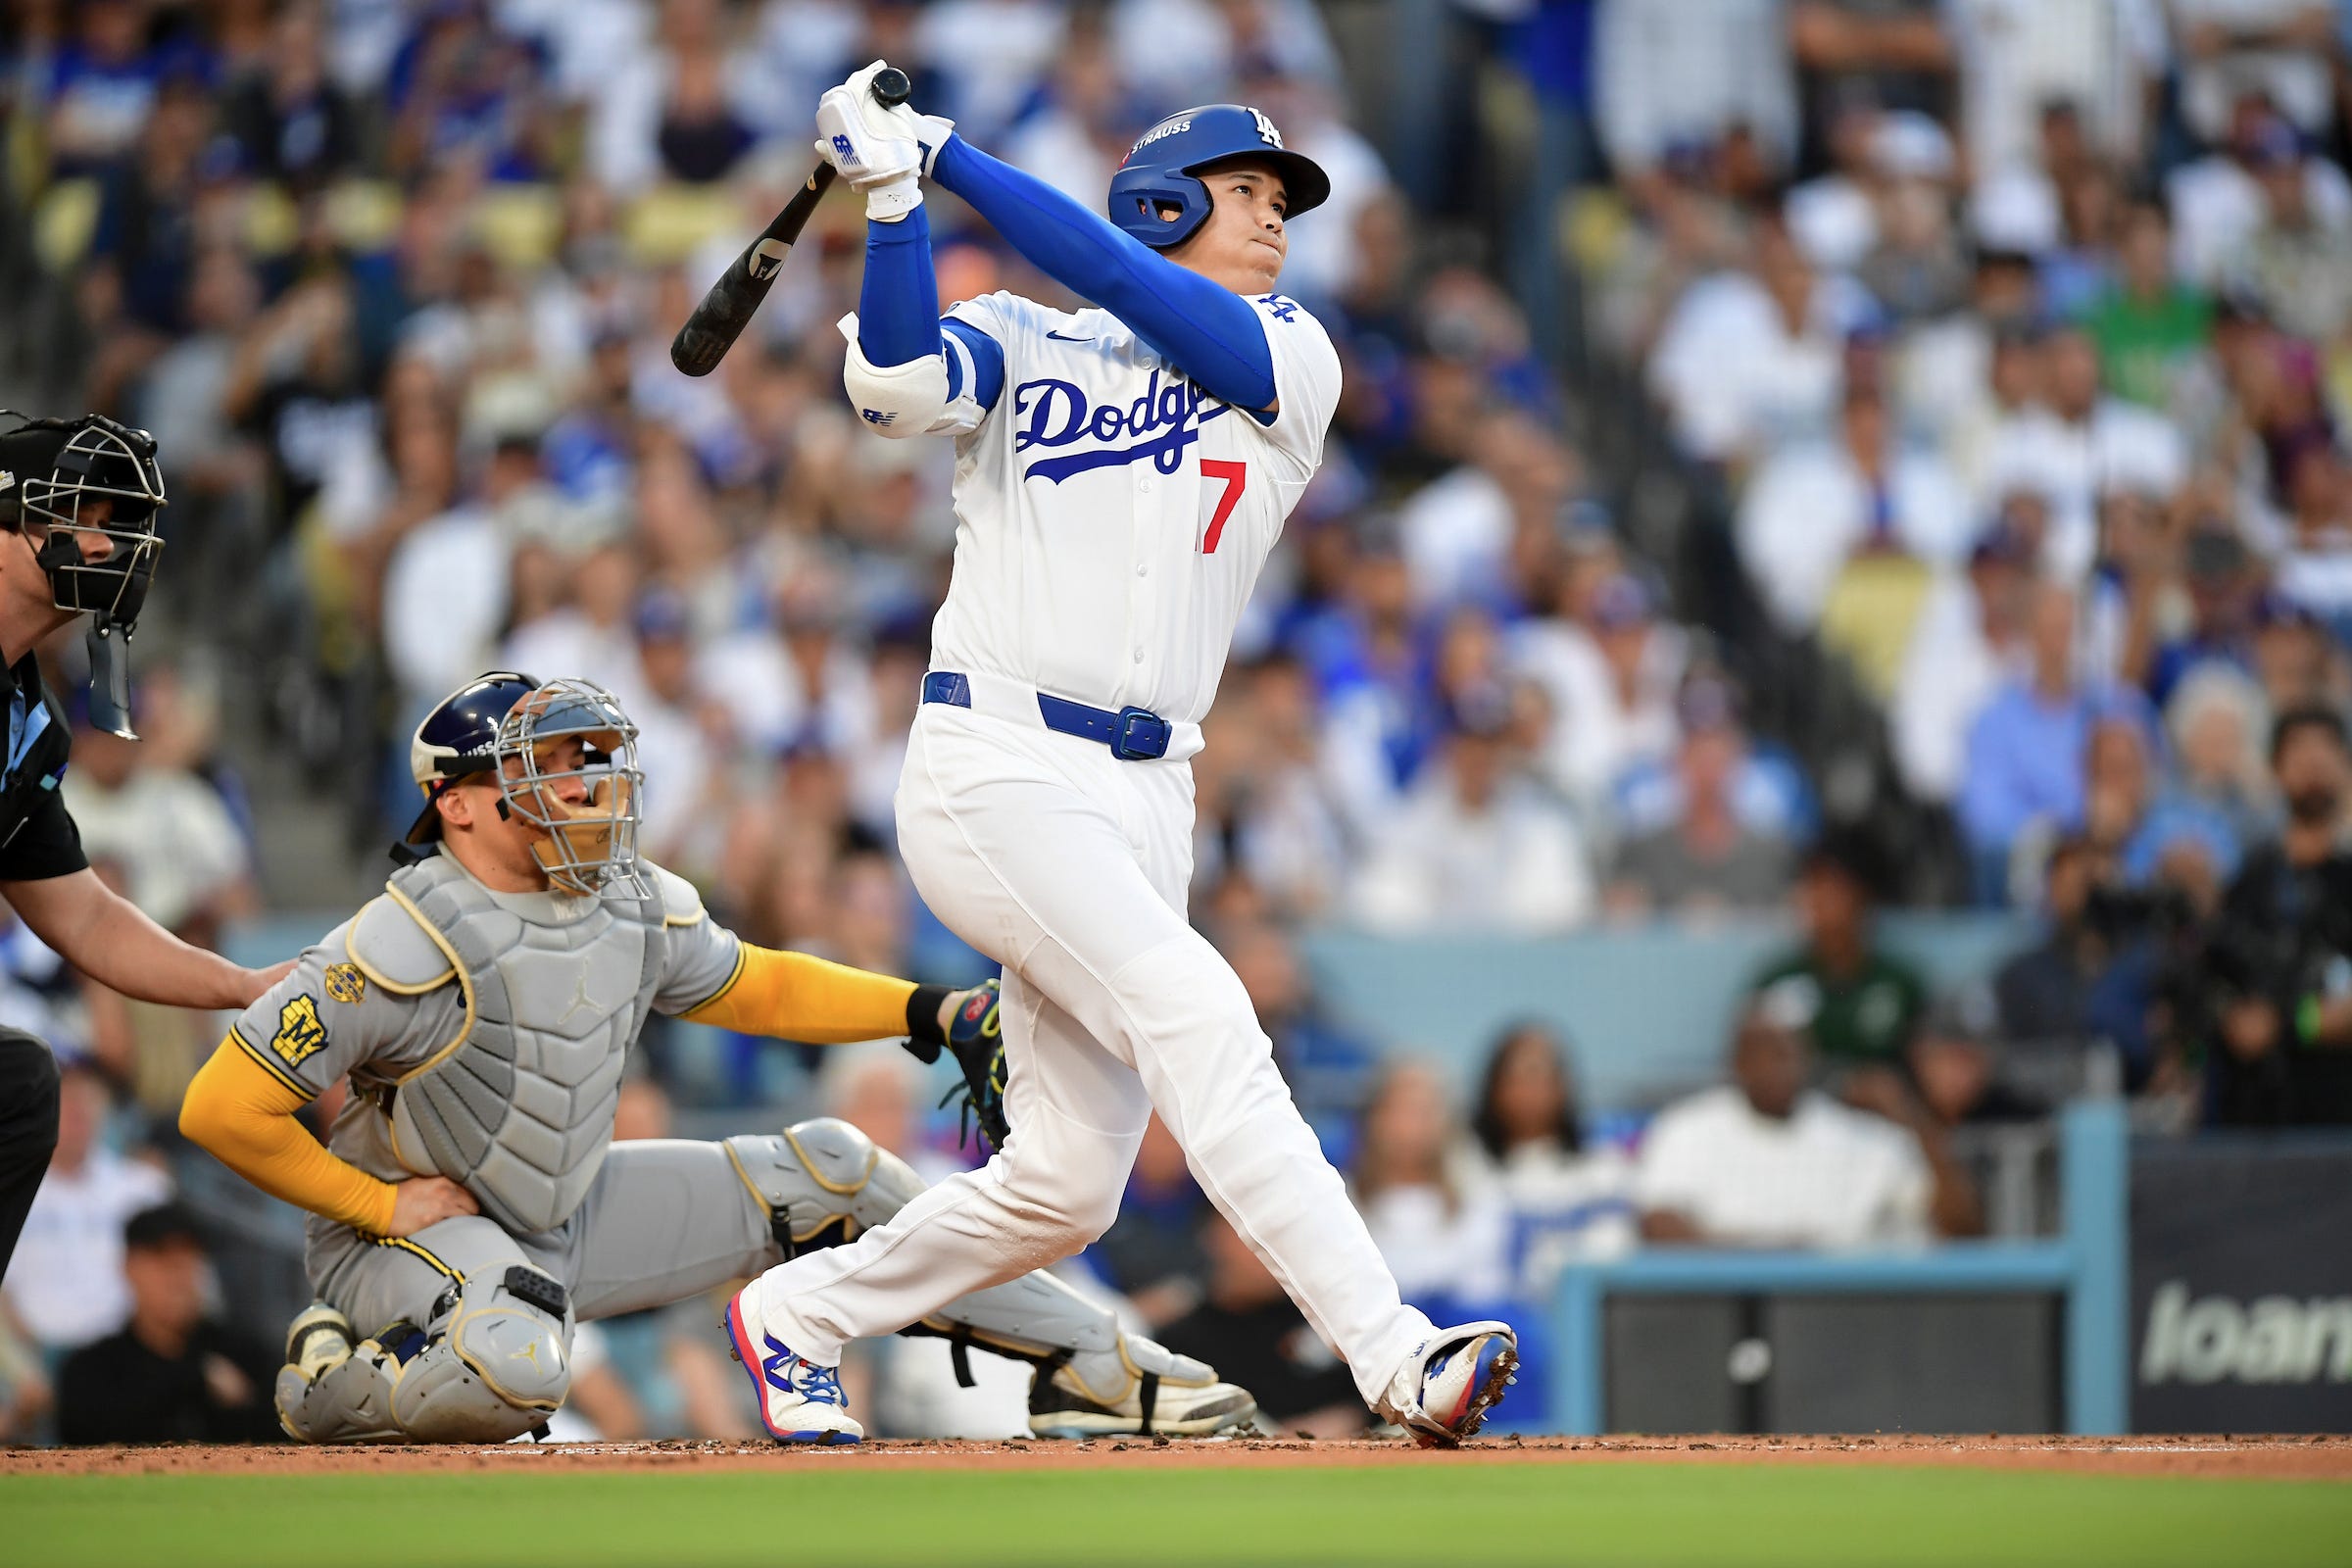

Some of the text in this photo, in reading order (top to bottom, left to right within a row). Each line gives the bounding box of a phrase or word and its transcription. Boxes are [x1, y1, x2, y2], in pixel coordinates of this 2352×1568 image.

[1132, 121, 1191, 154] STRAUSS
[1247, 107, 1284, 149] LA
[1015, 368, 1231, 475] Dodge
[1196, 459, 1246, 555] 7
[2142, 1280, 2352, 1383] loan
